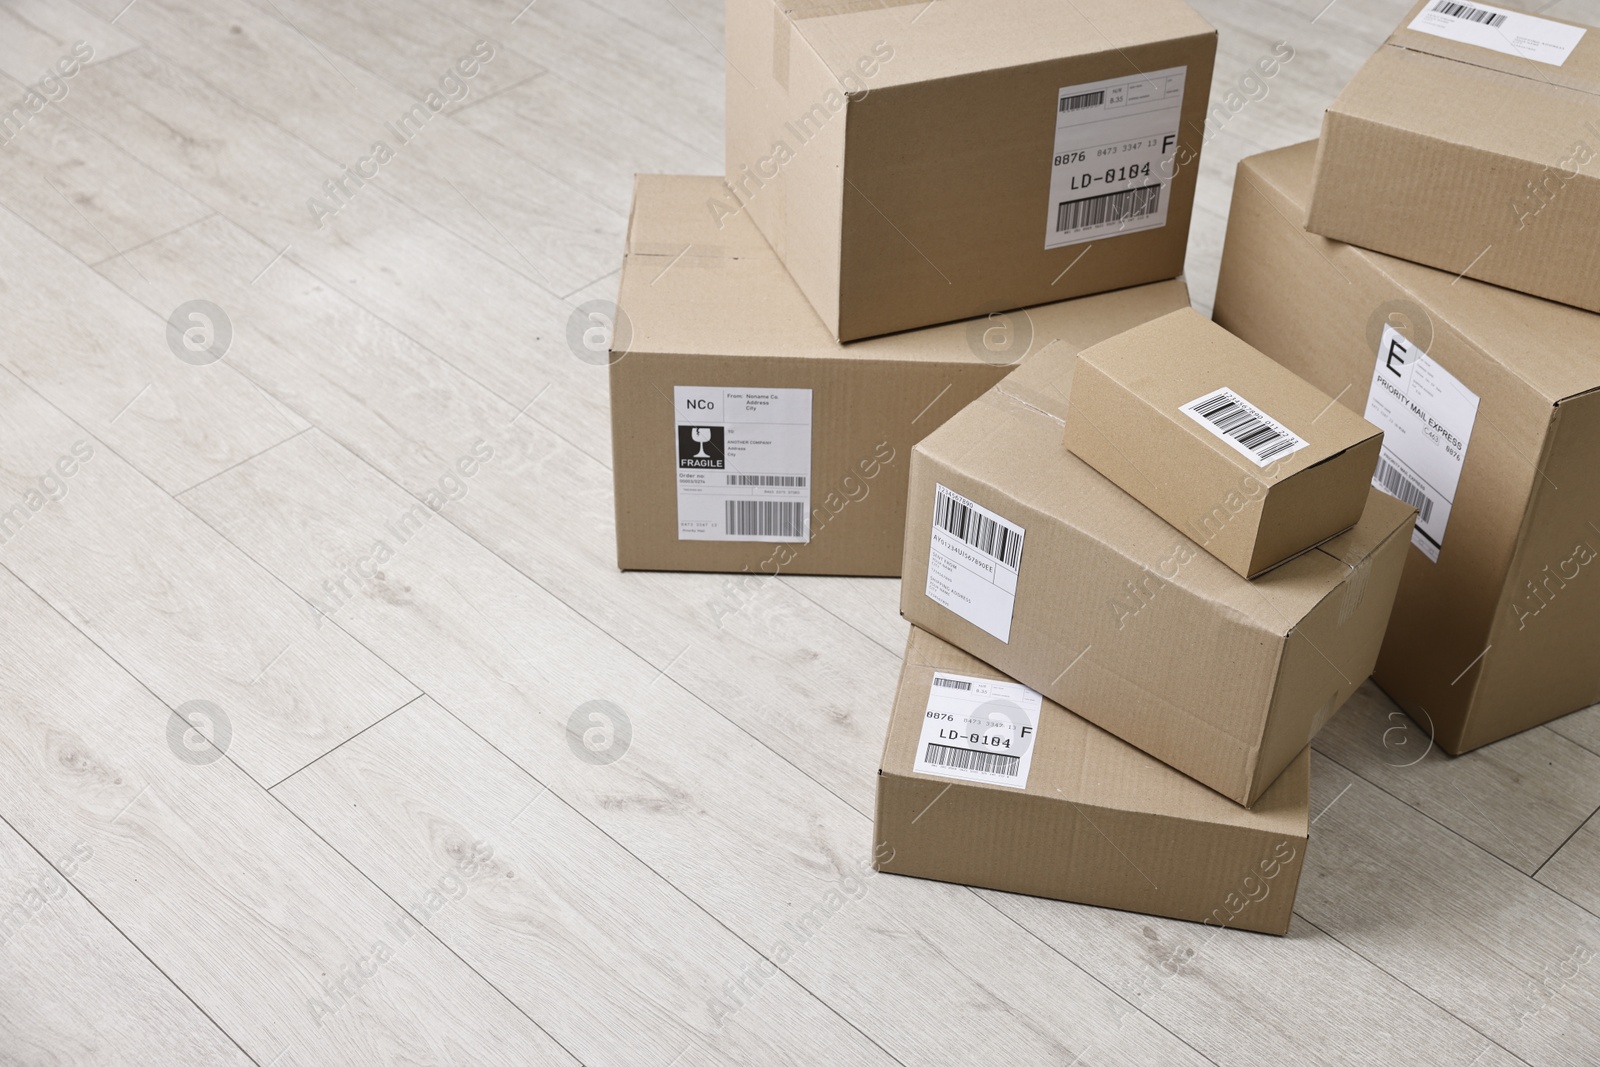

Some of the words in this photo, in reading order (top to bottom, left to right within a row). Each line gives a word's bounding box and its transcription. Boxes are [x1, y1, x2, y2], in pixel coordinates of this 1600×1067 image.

[1097, 147, 1117, 157] 8473
[1122, 142, 1143, 153] 3347
[1148, 139, 1157, 147] 13
[1162, 134, 1176, 154] F
[1071, 162, 1151, 190] LD-0104
[1386, 339, 1407, 378] E
[687, 399, 715, 410] NCo
[1224, 392, 1264, 420] 1234567890
[1377, 375, 1410, 406] PRIORITY
[1410, 403, 1427, 422] MAIL
[1428, 418, 1462, 451] EXPRESS
[681, 459, 723, 468] FRAGILE
[938, 486, 974, 509] 1234567890
[933, 552, 944, 561] SENT
[944, 558, 957, 569] FROM
[930, 576, 950, 591] SHIPPING
[951, 589, 971, 604] ADDRESS
[940, 729, 1011, 749] LD-0104
[1021, 726, 1033, 738] F
